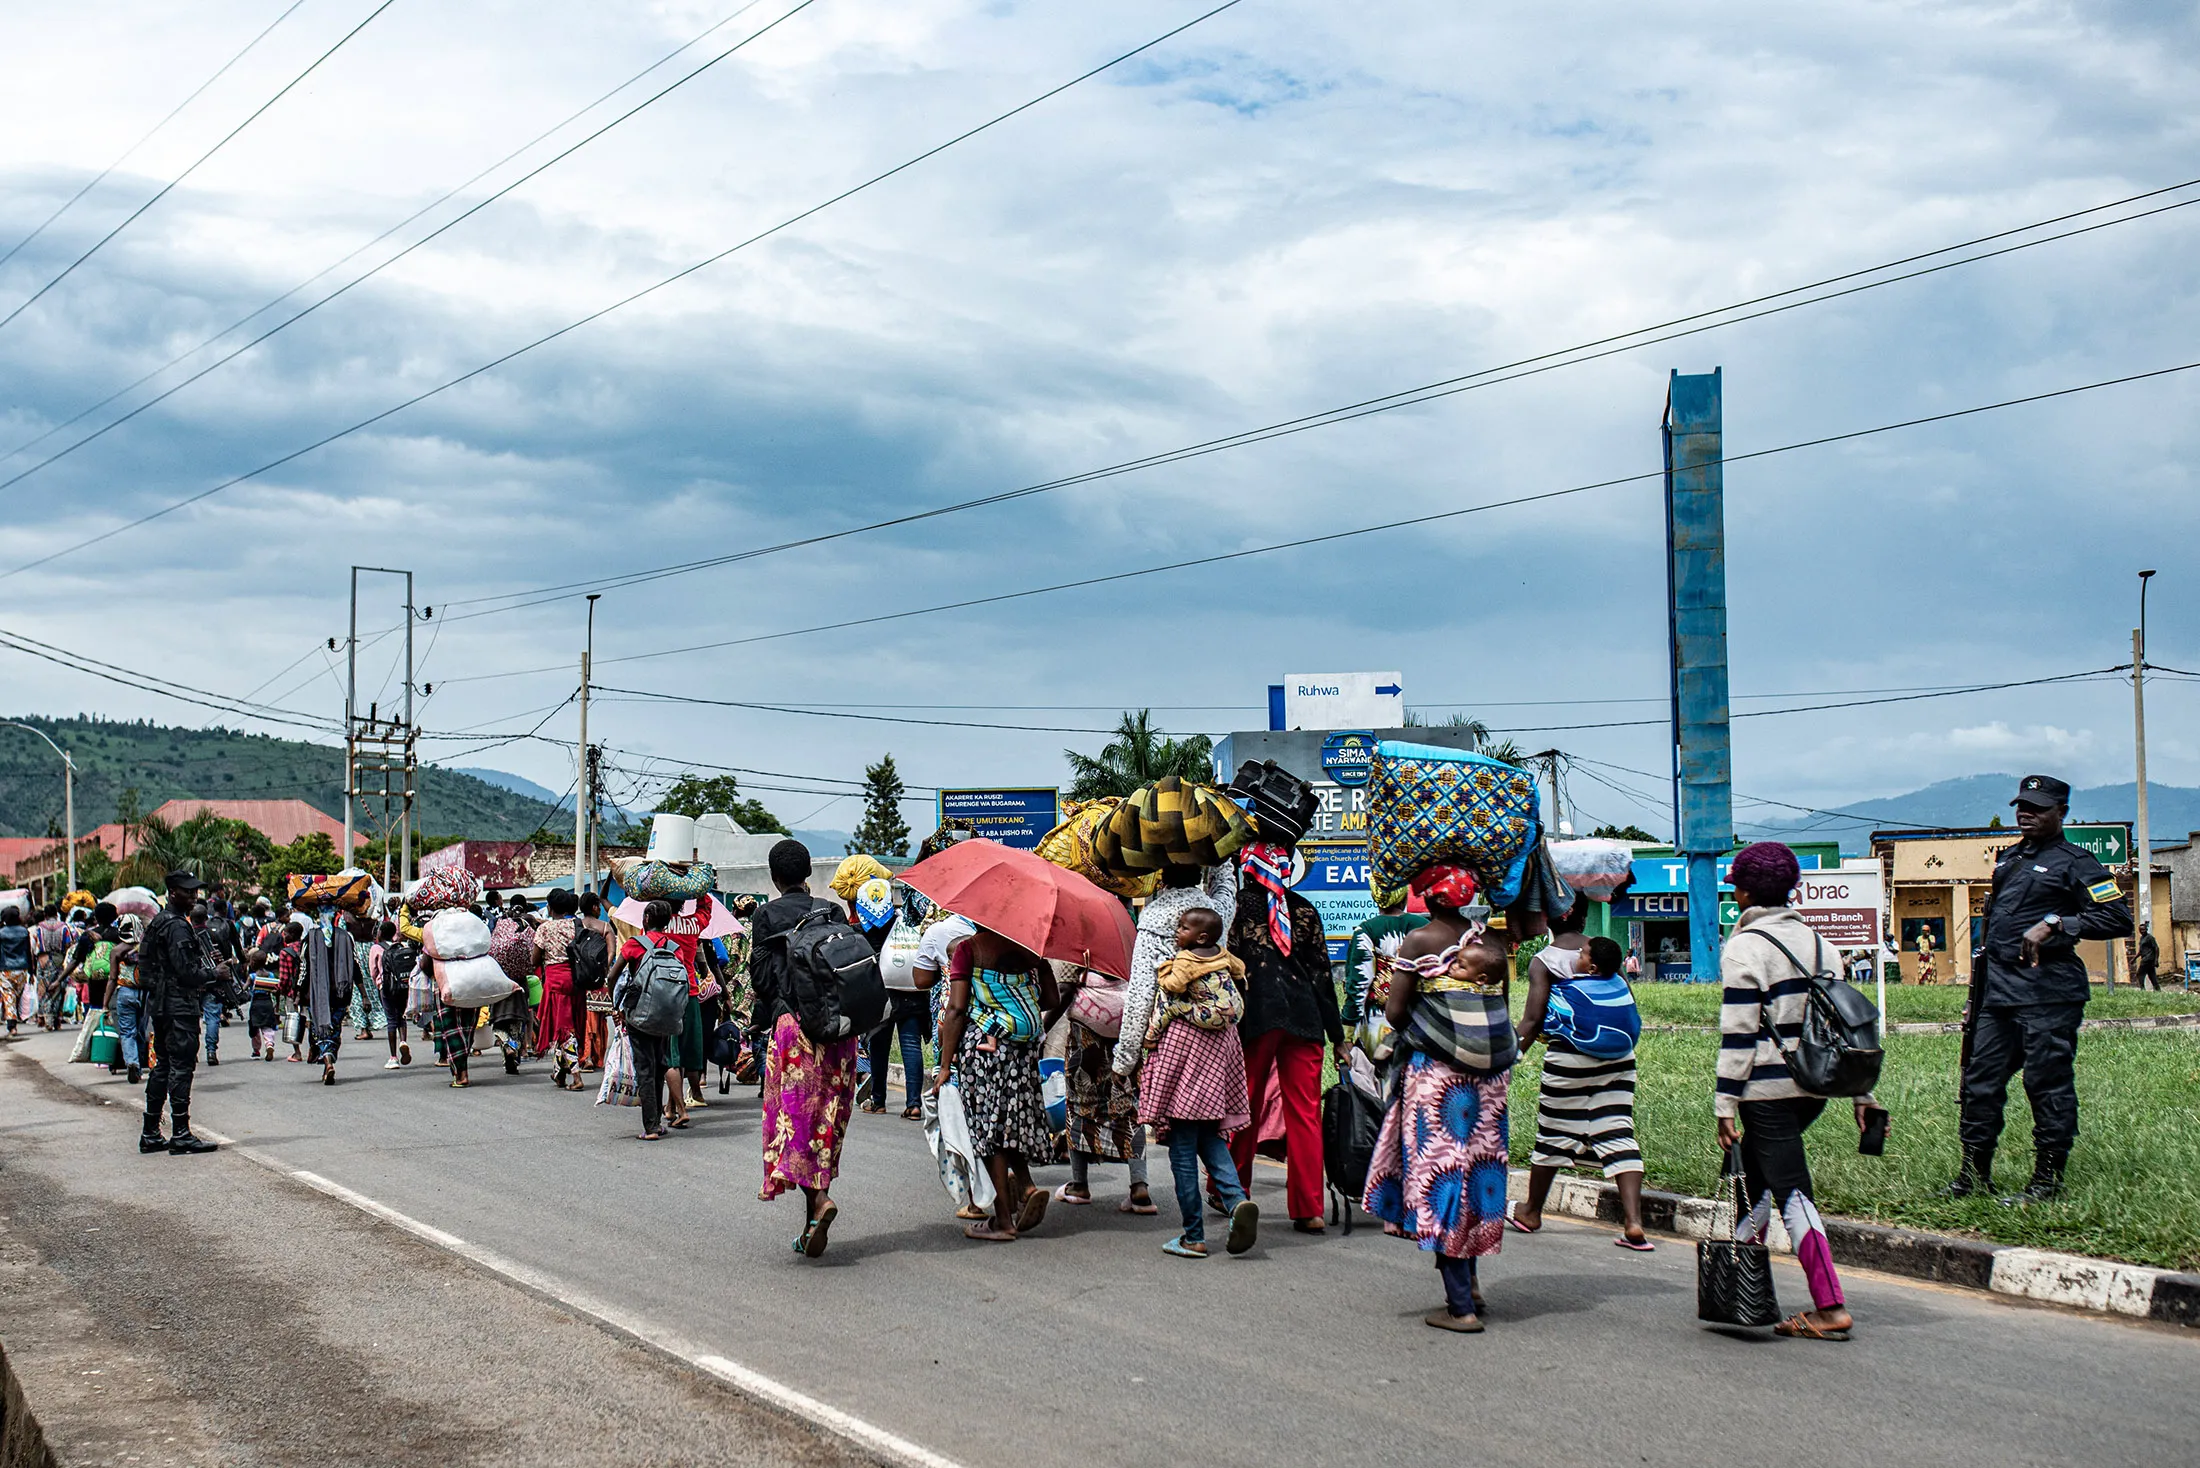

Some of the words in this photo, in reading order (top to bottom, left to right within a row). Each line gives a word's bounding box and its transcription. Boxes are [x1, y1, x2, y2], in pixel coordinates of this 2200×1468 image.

[1298, 685, 1339, 697] Ruhwa
[1338, 748, 1366, 758] SIMA
[1310, 788, 1342, 812] RE
[976, 816, 1025, 824] UMUTEKANO
[1310, 813, 1333, 830] TE
[1806, 881, 1849, 900] brac
[1315, 901, 1327, 909] DE
[1629, 895, 1688, 912] TECN
[1320, 912, 1367, 921] UGARAMA
[1831, 912, 1863, 922] Branch
